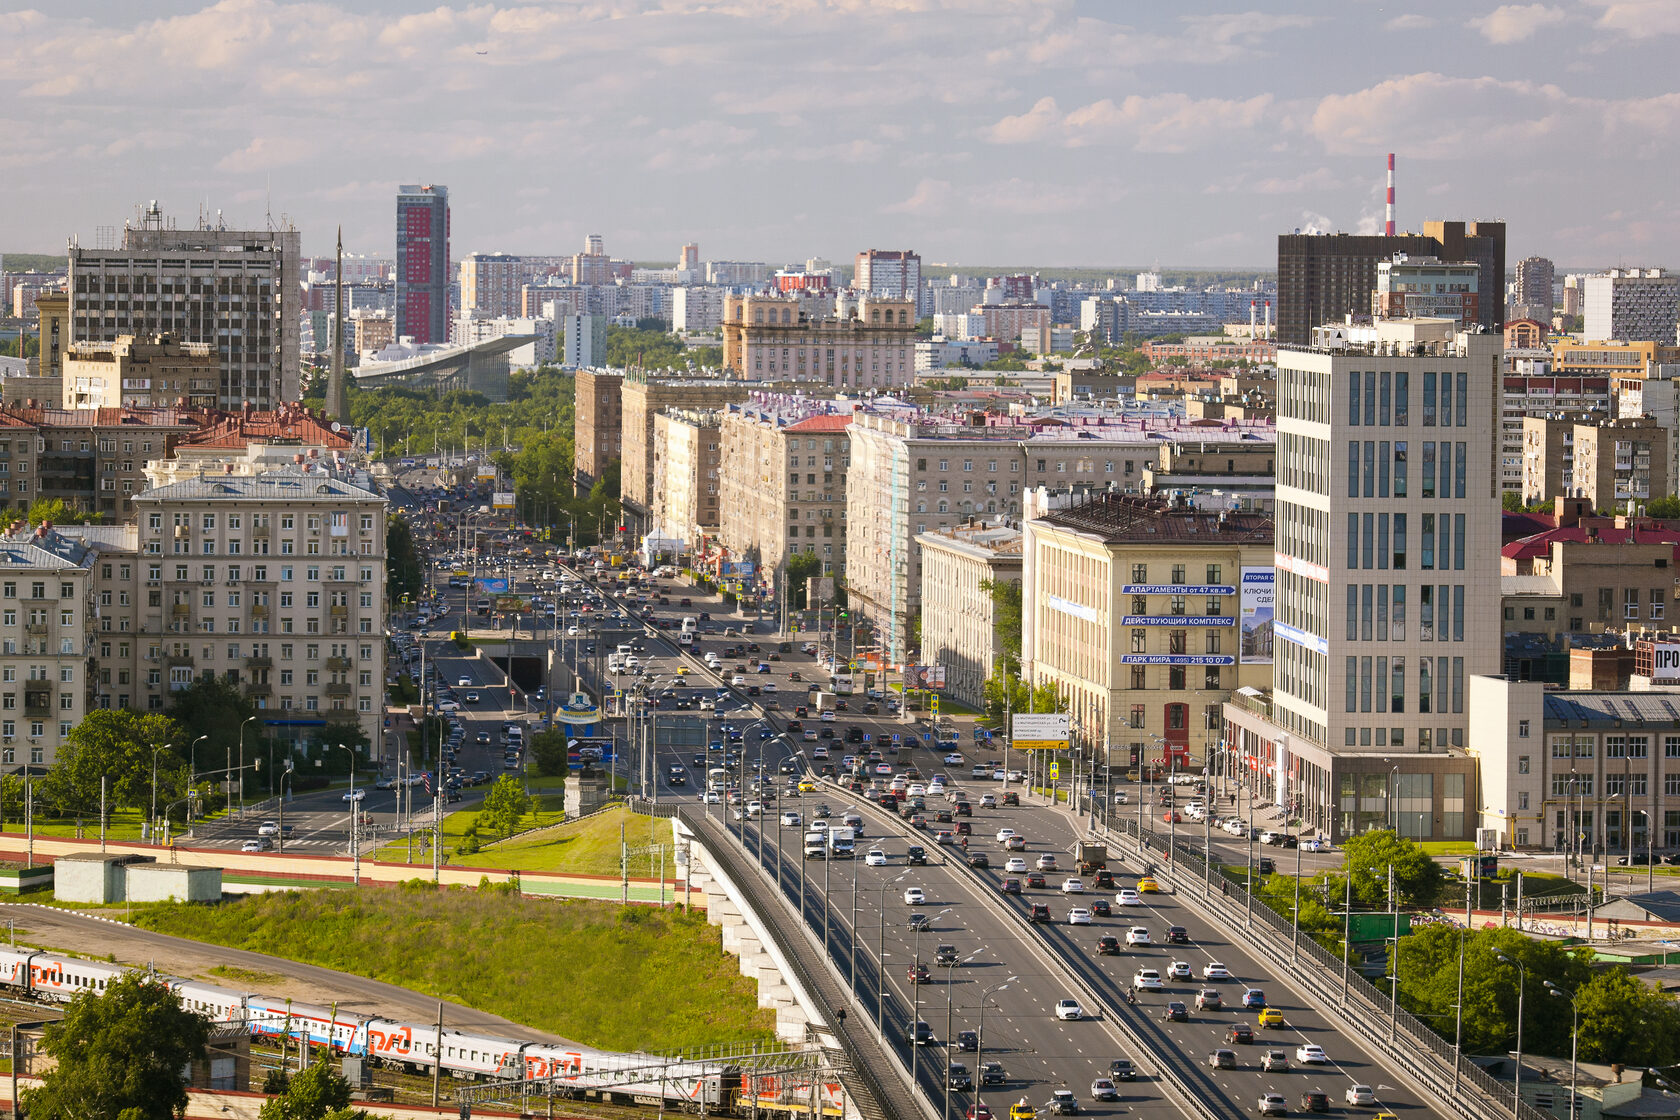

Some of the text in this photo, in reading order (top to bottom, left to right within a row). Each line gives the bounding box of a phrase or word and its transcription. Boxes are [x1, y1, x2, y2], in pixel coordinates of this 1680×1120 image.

[1130, 586, 1188, 594] АПАРТАМЕНТЫ
[1124, 616, 1188, 626] ДЕЙСТВУЮЩИЙ
[1656, 650, 1679, 668] ПРО
